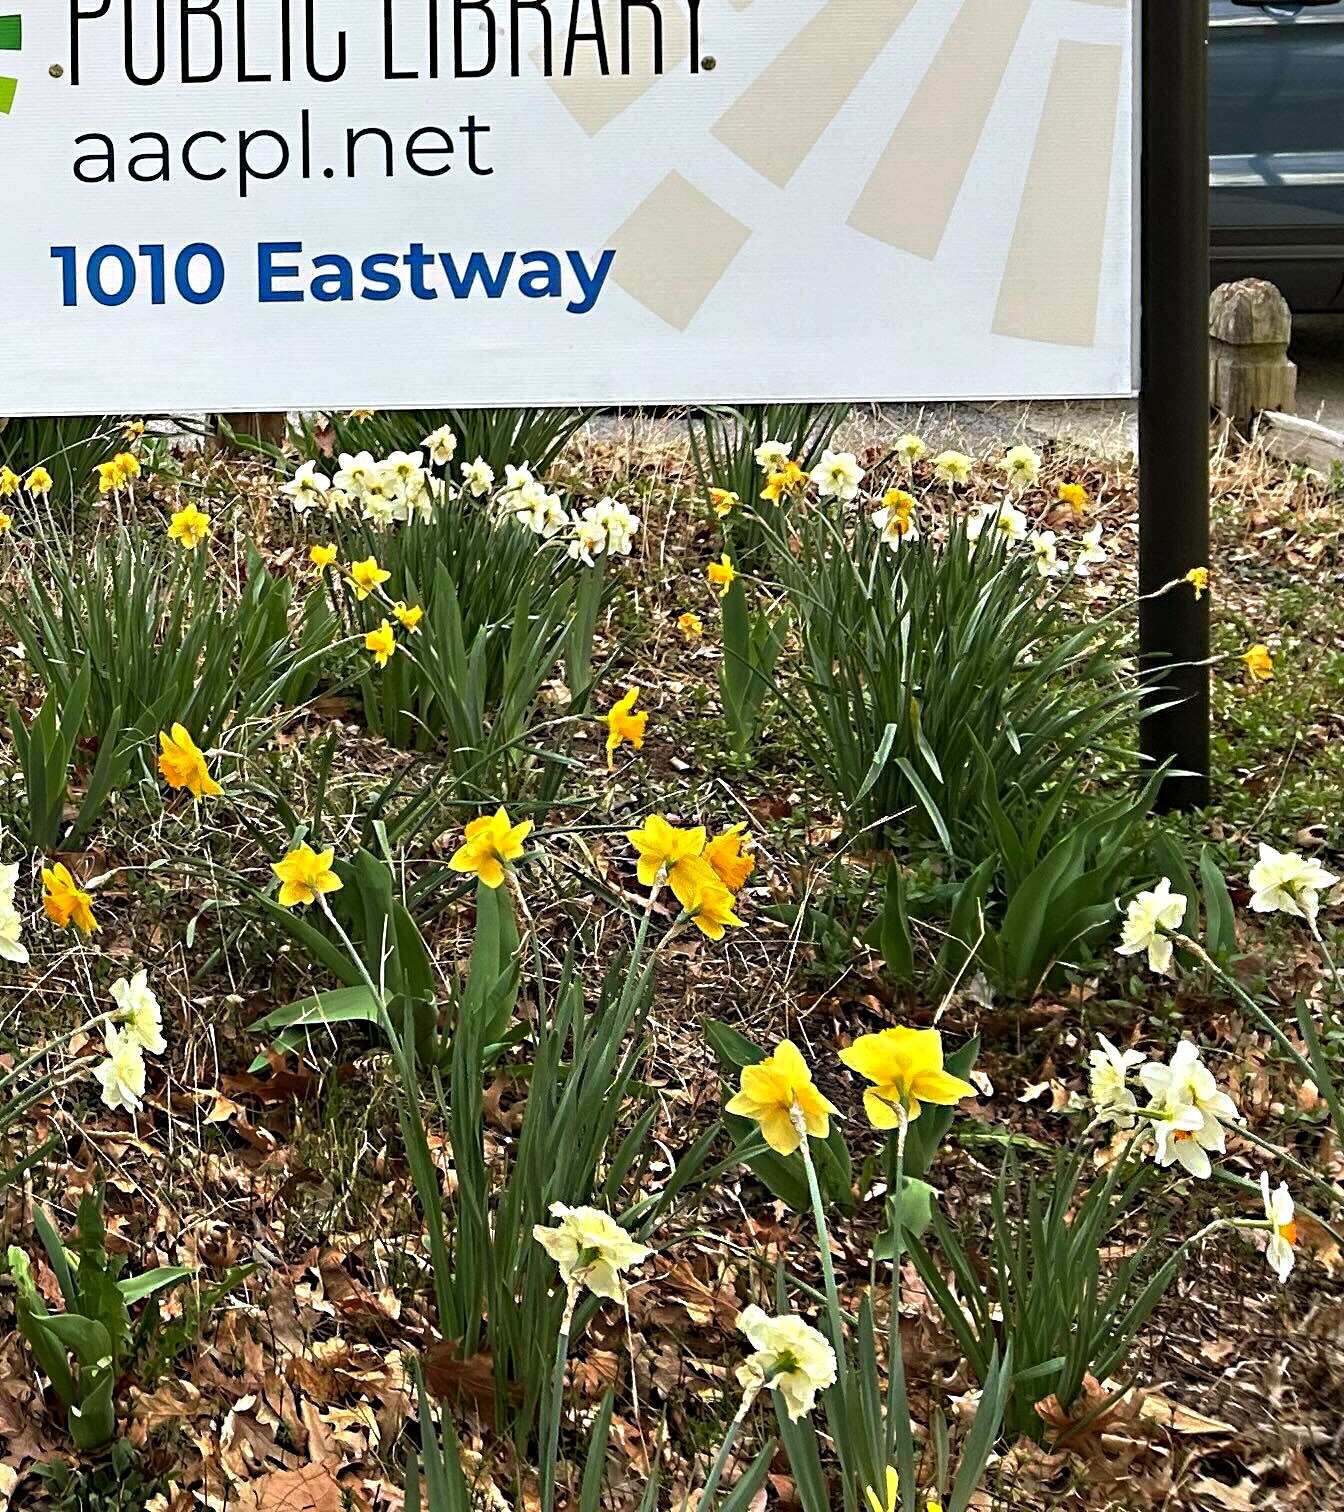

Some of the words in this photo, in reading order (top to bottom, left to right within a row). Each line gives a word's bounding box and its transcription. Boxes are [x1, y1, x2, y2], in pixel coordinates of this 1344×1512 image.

[71, 109, 494, 197] aacpl.net
[50, 242, 225, 307] 1010
[256, 241, 617, 314] Eastway
